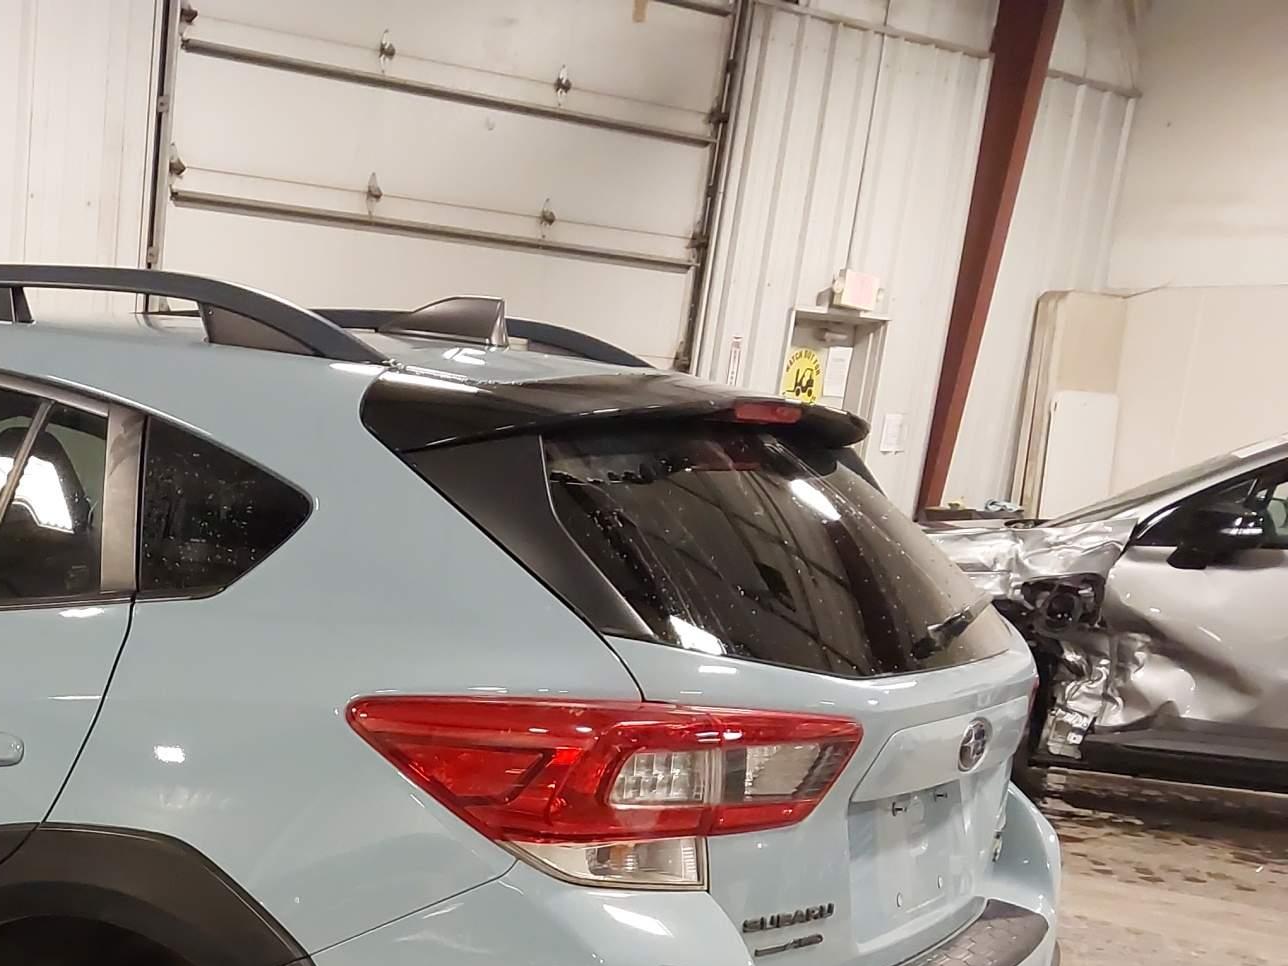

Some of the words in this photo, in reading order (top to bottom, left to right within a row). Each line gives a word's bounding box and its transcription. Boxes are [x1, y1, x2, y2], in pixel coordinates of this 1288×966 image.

[786, 350, 803, 372] WATCH
[804, 350, 816, 361] OUT
[742, 902, 835, 933] SUBARU
